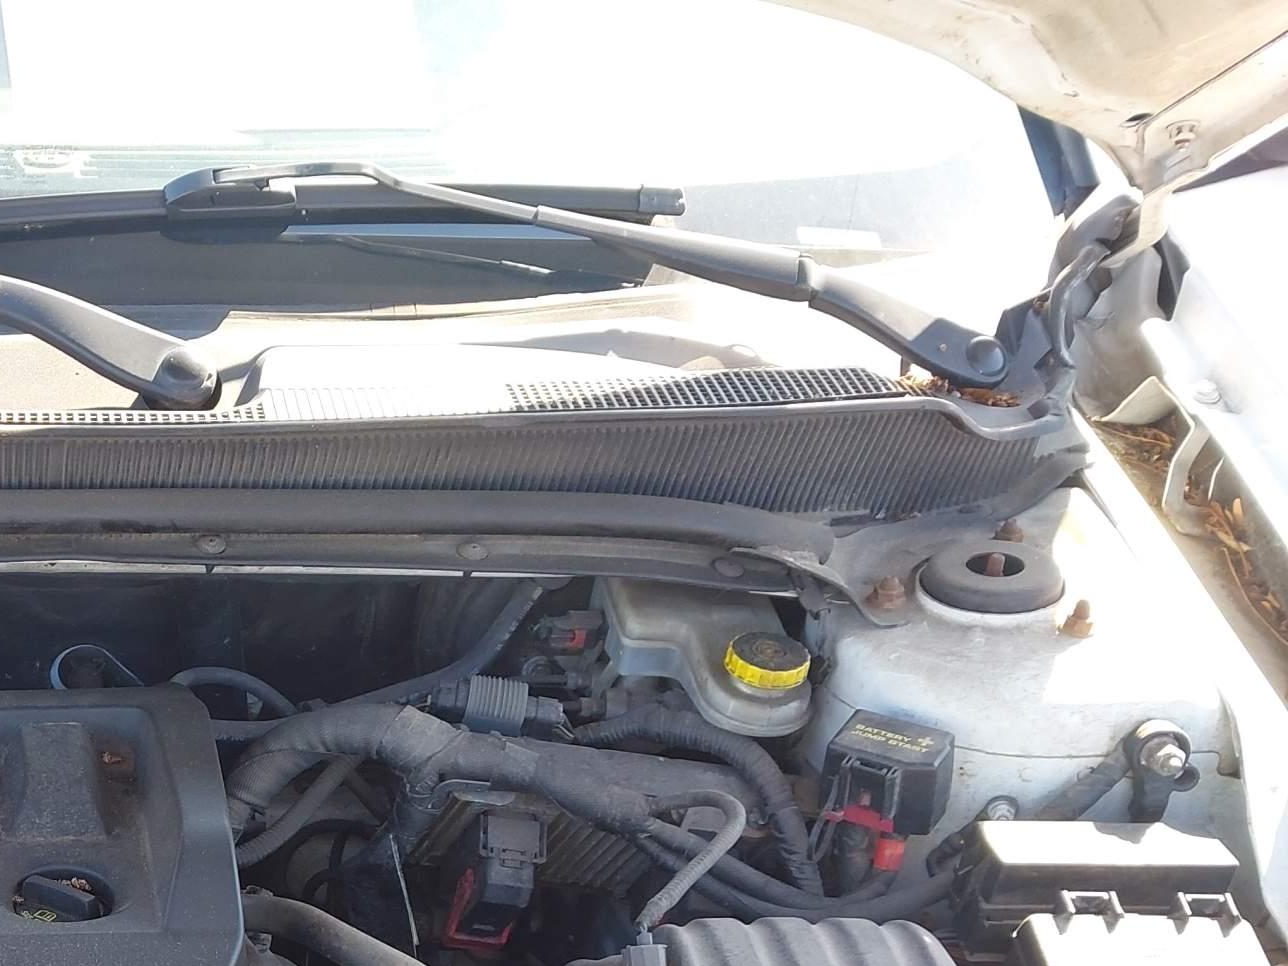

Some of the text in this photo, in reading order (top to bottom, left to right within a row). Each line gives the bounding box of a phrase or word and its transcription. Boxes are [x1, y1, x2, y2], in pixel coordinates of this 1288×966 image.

[851, 730, 929, 753] JUMP START
[855, 723, 912, 742] BATTERY
